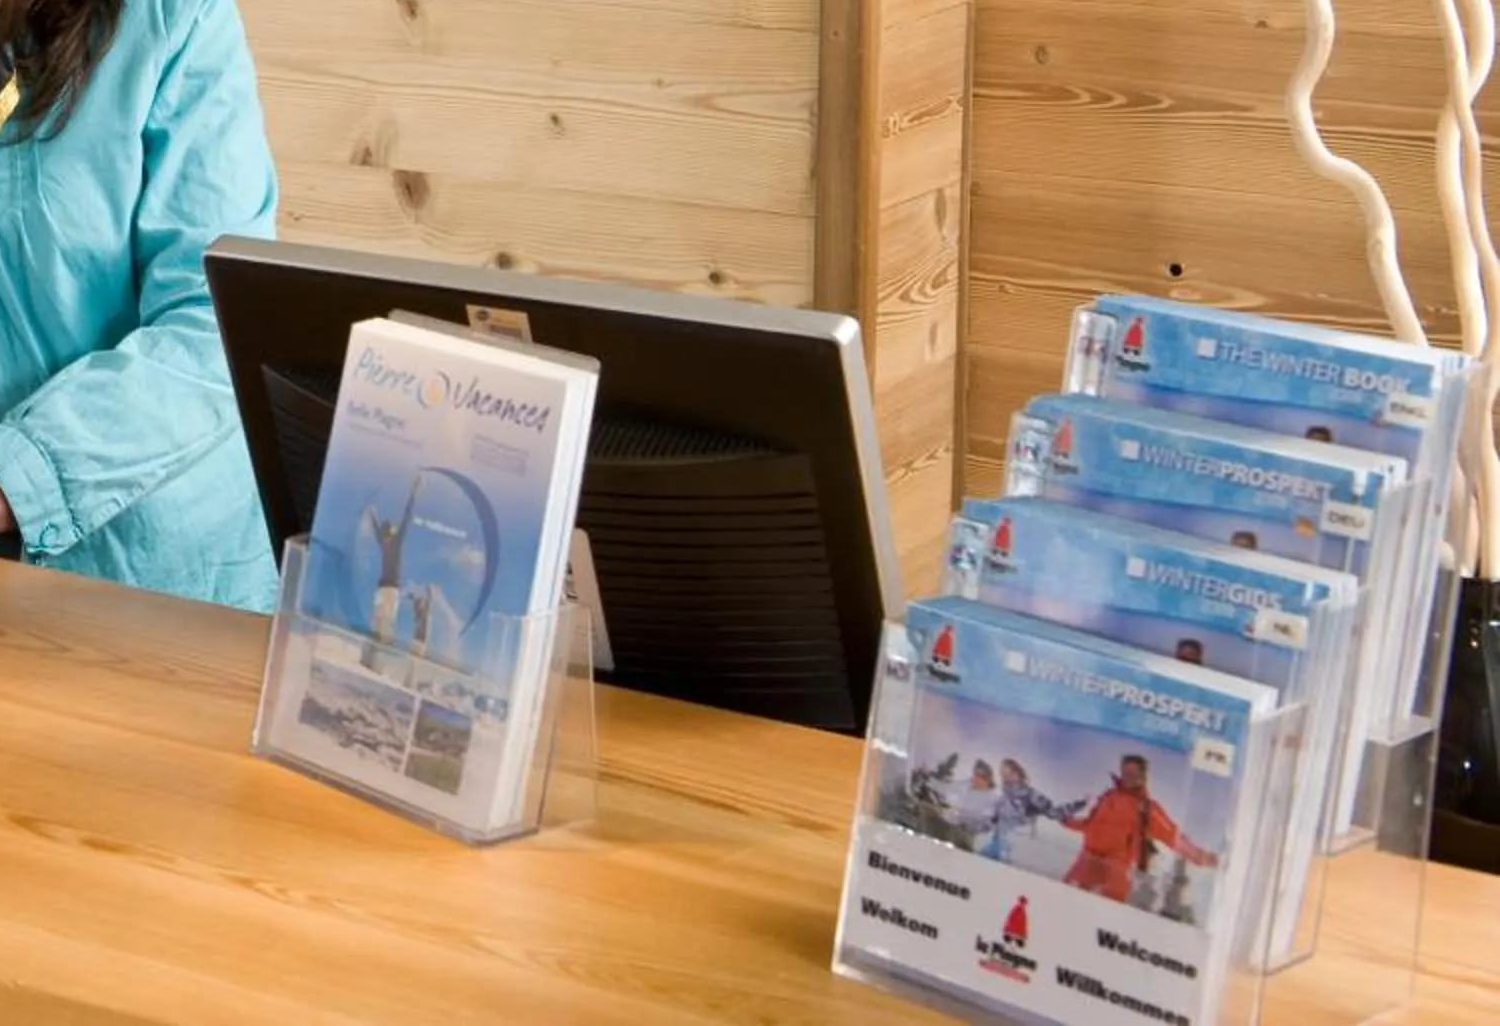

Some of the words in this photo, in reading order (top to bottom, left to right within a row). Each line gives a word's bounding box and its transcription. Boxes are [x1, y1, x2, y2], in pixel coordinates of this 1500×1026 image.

[354, 346, 417, 395] Pierre
[452, 375, 552, 431] Vacances
[1343, 368, 1412, 396] BOOK
[1139, 444, 1332, 503] WINTERPROSPEKT
[1026, 656, 1227, 732] WINTERPROSPEKT
[867, 850, 972, 901] Bienvenue
[860, 896, 939, 940] Welkom
[1096, 927, 1197, 979] Welcome
[1055, 966, 1192, 1026] Willkommen
